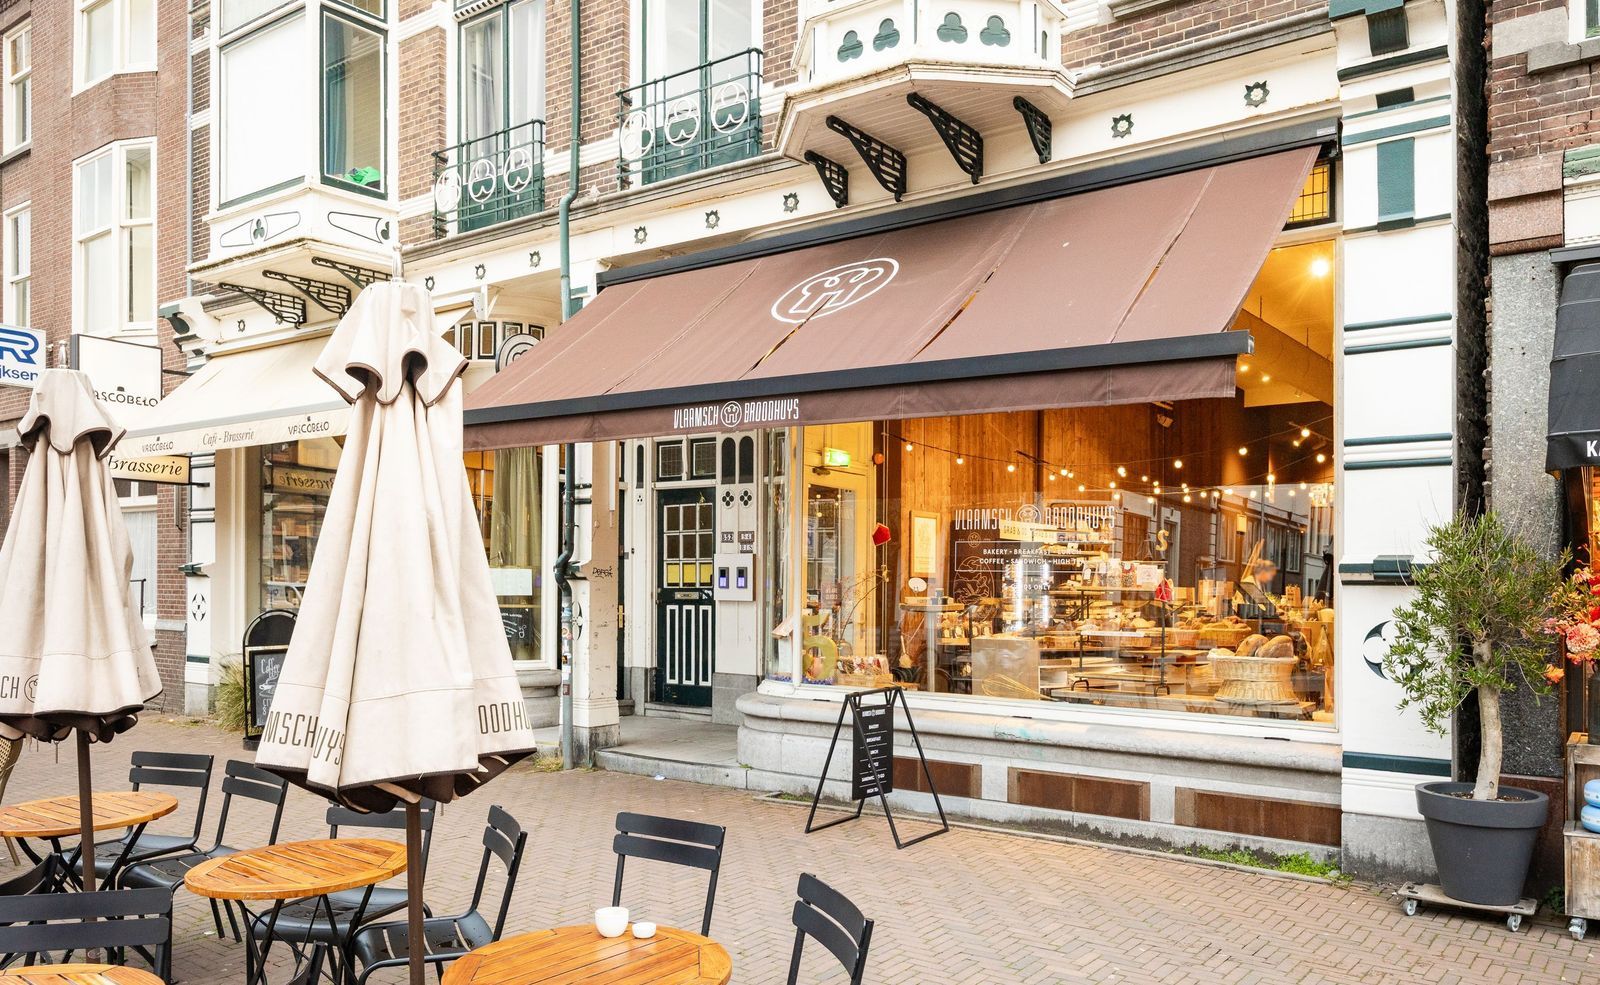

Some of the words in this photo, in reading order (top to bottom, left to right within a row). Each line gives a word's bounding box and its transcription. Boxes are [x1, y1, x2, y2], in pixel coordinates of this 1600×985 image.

[673, 405, 719, 429] VLAAMSCH
[744, 398, 799, 423] BROODHUYS
[1586, 440, 1600, 457] K
[107, 455, 182, 476] Brasserie
